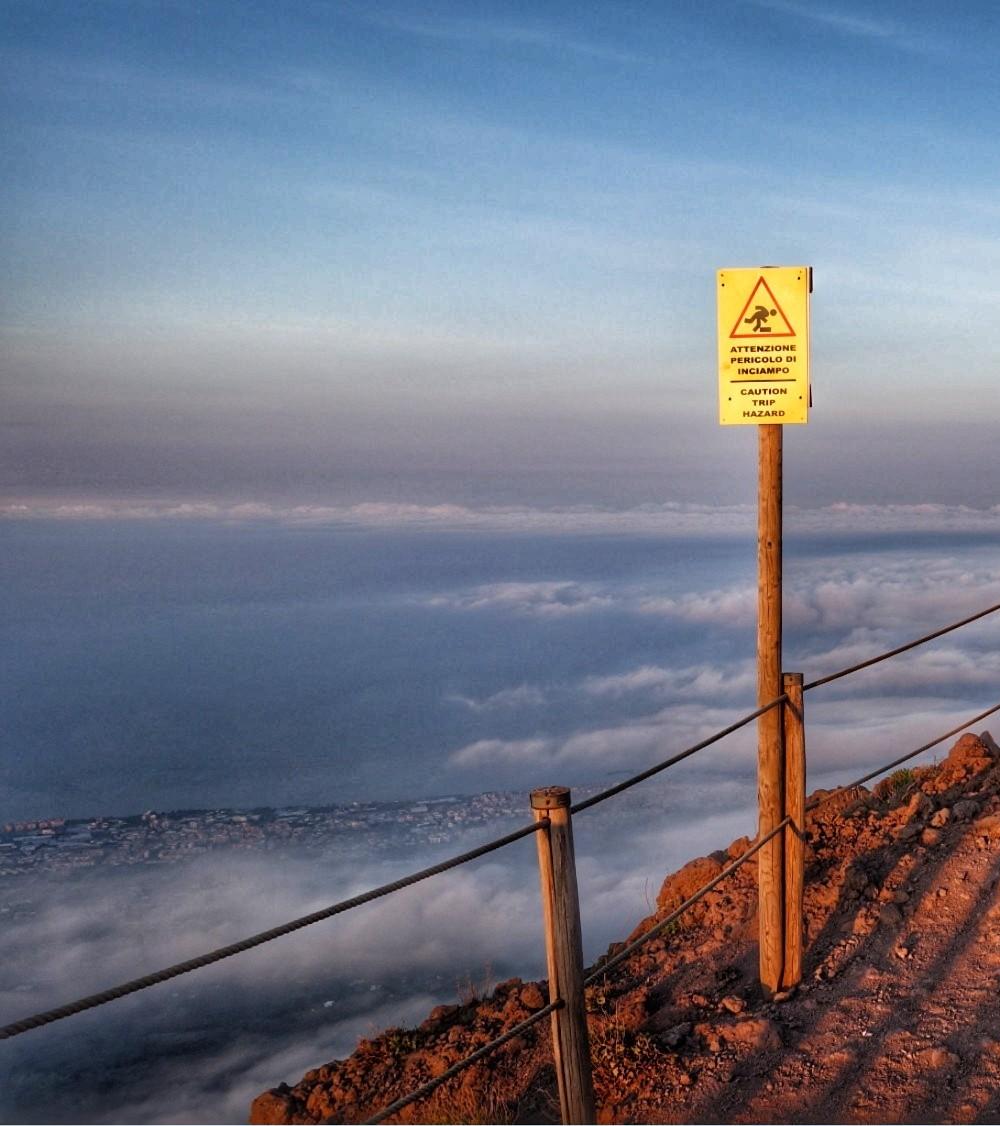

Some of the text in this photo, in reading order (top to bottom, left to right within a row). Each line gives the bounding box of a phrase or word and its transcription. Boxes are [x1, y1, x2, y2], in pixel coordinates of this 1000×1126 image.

[730, 345, 797, 353] ATTENZIONE
[730, 355, 797, 364] PERICOLO DI
[737, 367, 790, 375] INCIAMPO
[740, 388, 788, 396] CAUTION
[742, 410, 786, 418] HAZARD
